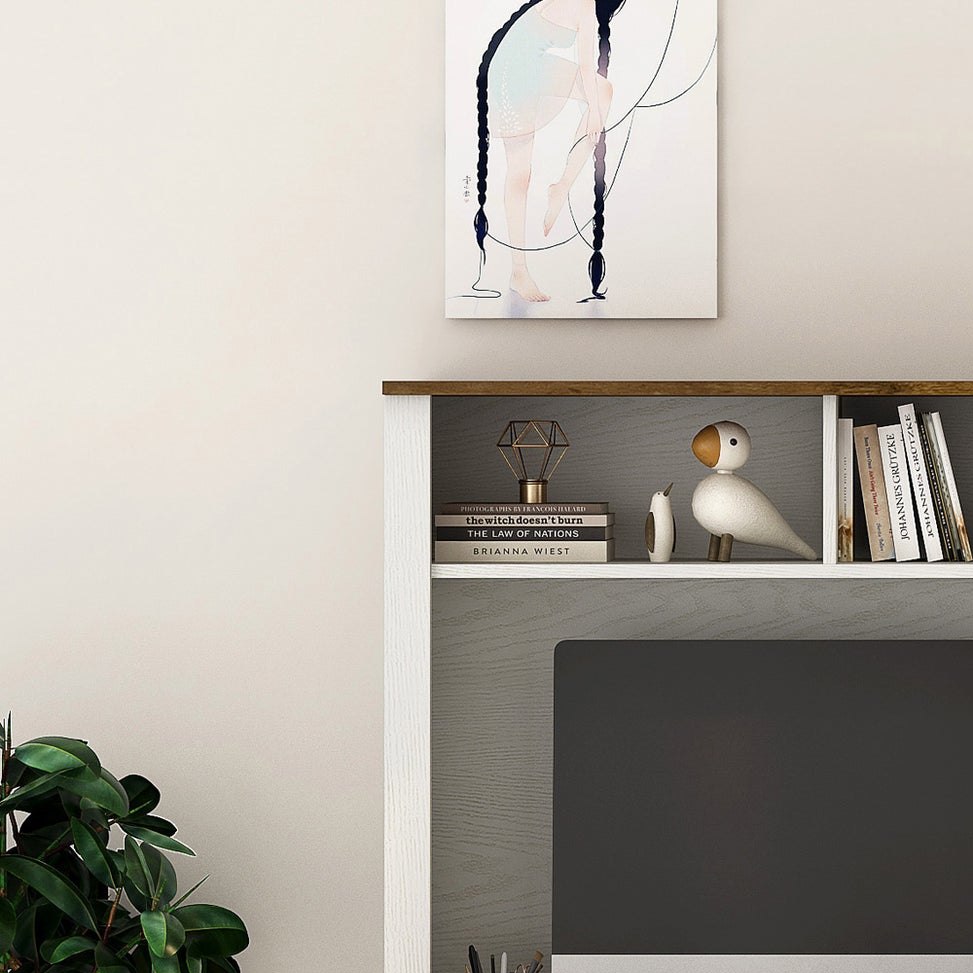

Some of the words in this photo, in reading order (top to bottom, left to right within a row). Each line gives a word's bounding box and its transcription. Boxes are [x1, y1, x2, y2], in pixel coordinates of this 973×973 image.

[885, 433, 901, 484] GRÜTZKE
[904, 413, 921, 472] GRÜTZKE
[893, 485, 910, 540] JOHANNES
[914, 473, 935, 538] JOHANNES
[467, 530, 488, 538] THE
[492, 530, 514, 538] LAW
[516, 530, 530, 538] OF
[534, 530, 579, 538] NATIONS
[473, 547, 529, 555] BRIANNA
[534, 547, 570, 555] WIEST
